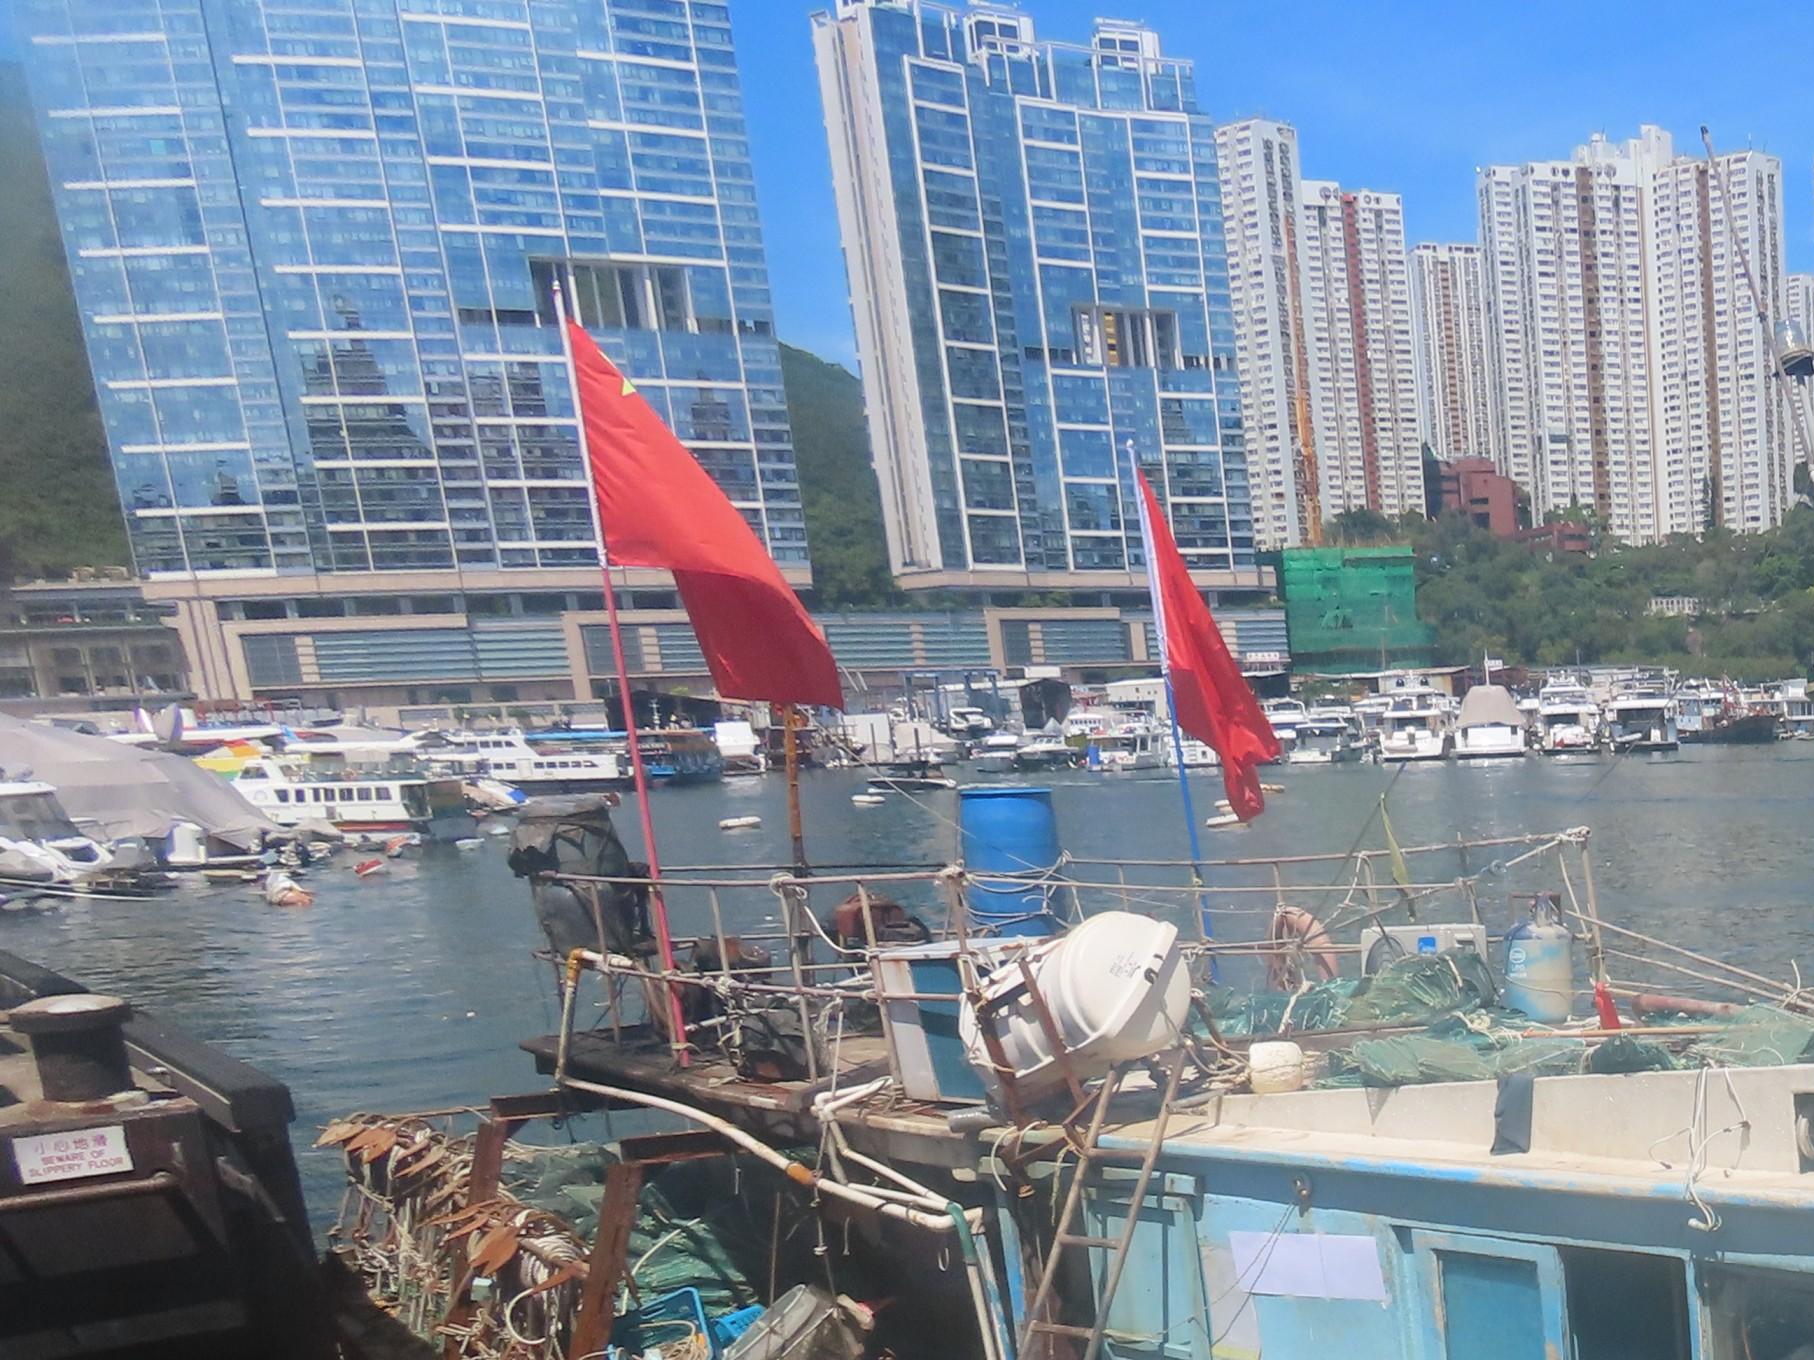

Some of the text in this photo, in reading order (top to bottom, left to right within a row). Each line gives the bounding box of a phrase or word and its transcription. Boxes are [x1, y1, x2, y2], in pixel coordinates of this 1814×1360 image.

[34, 1134, 107, 1154] 小心地滑
[28, 1157, 123, 1178] SLIPPERY FLOOR
[41, 1149, 105, 1166] BEWARE OF
